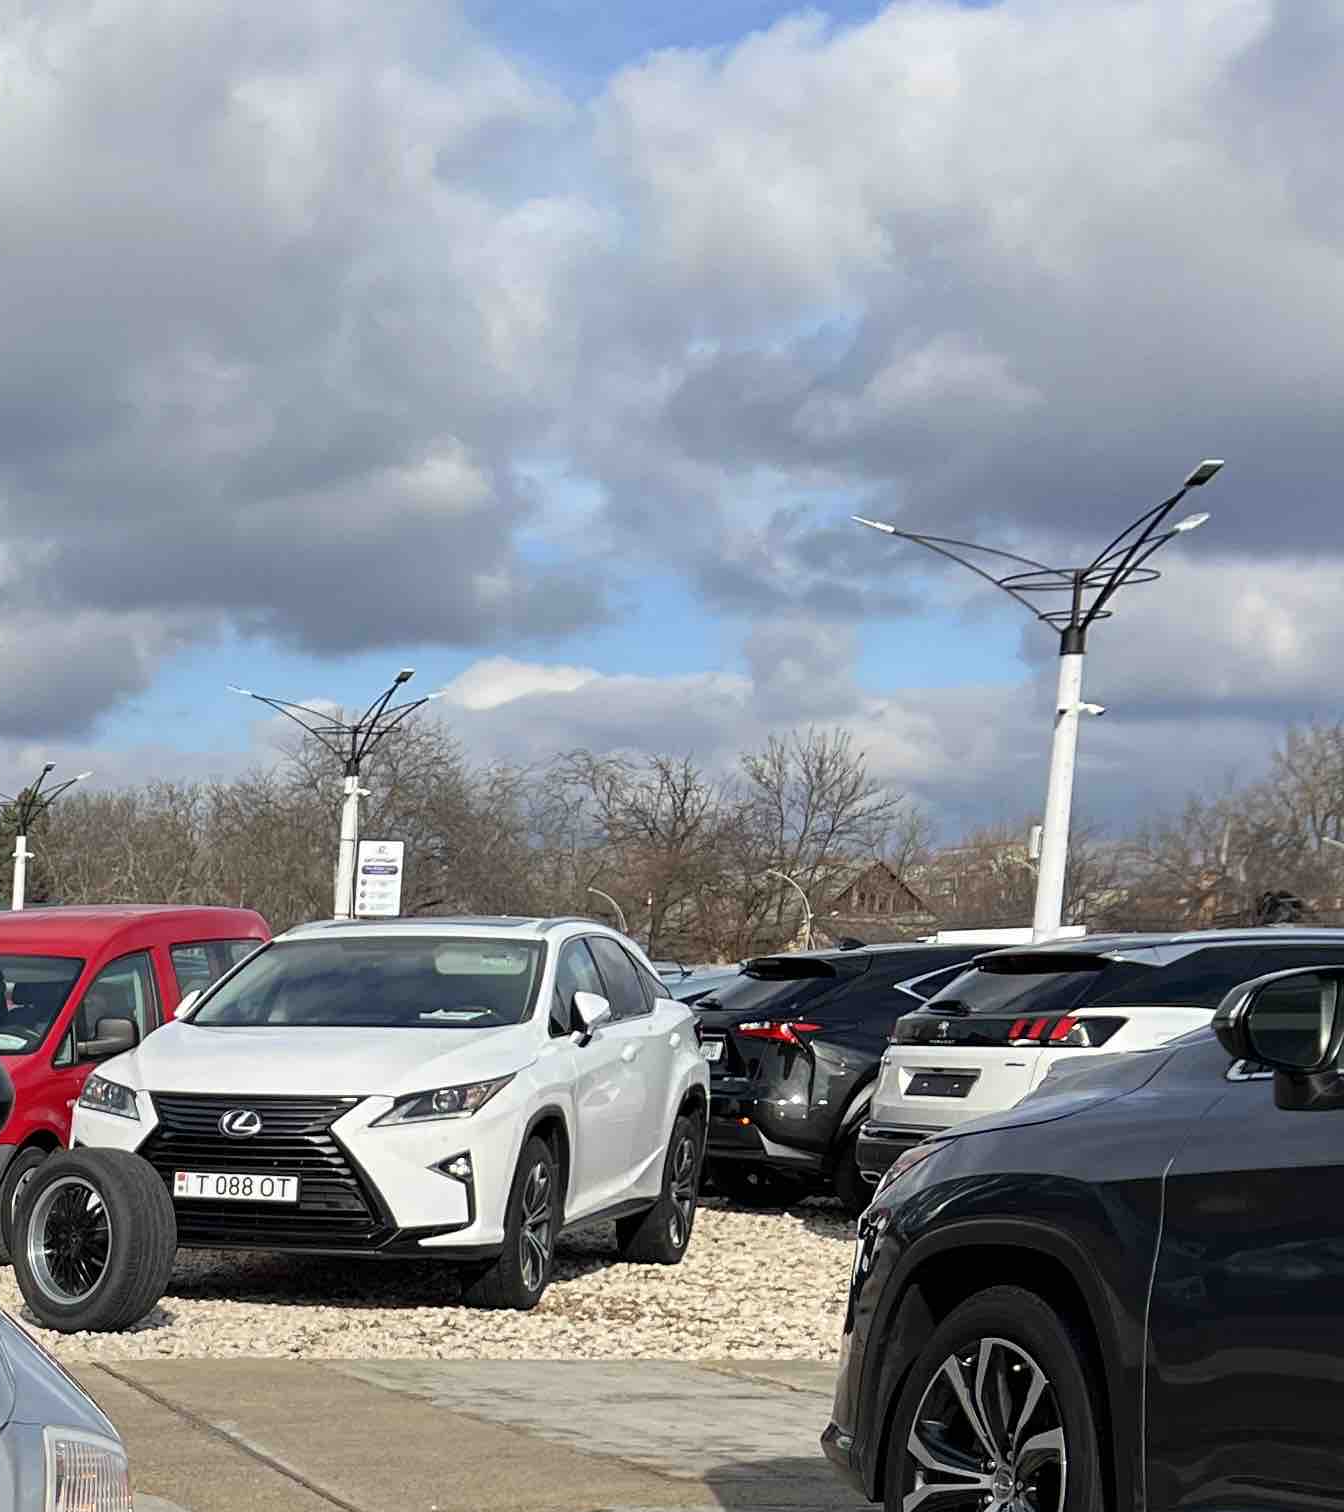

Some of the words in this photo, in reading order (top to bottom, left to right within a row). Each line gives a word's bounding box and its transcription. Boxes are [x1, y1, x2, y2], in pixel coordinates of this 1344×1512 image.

[196, 1174, 210, 1194] T
[215, 1176, 253, 1197] 088
[260, 1177, 291, 1198] OT
